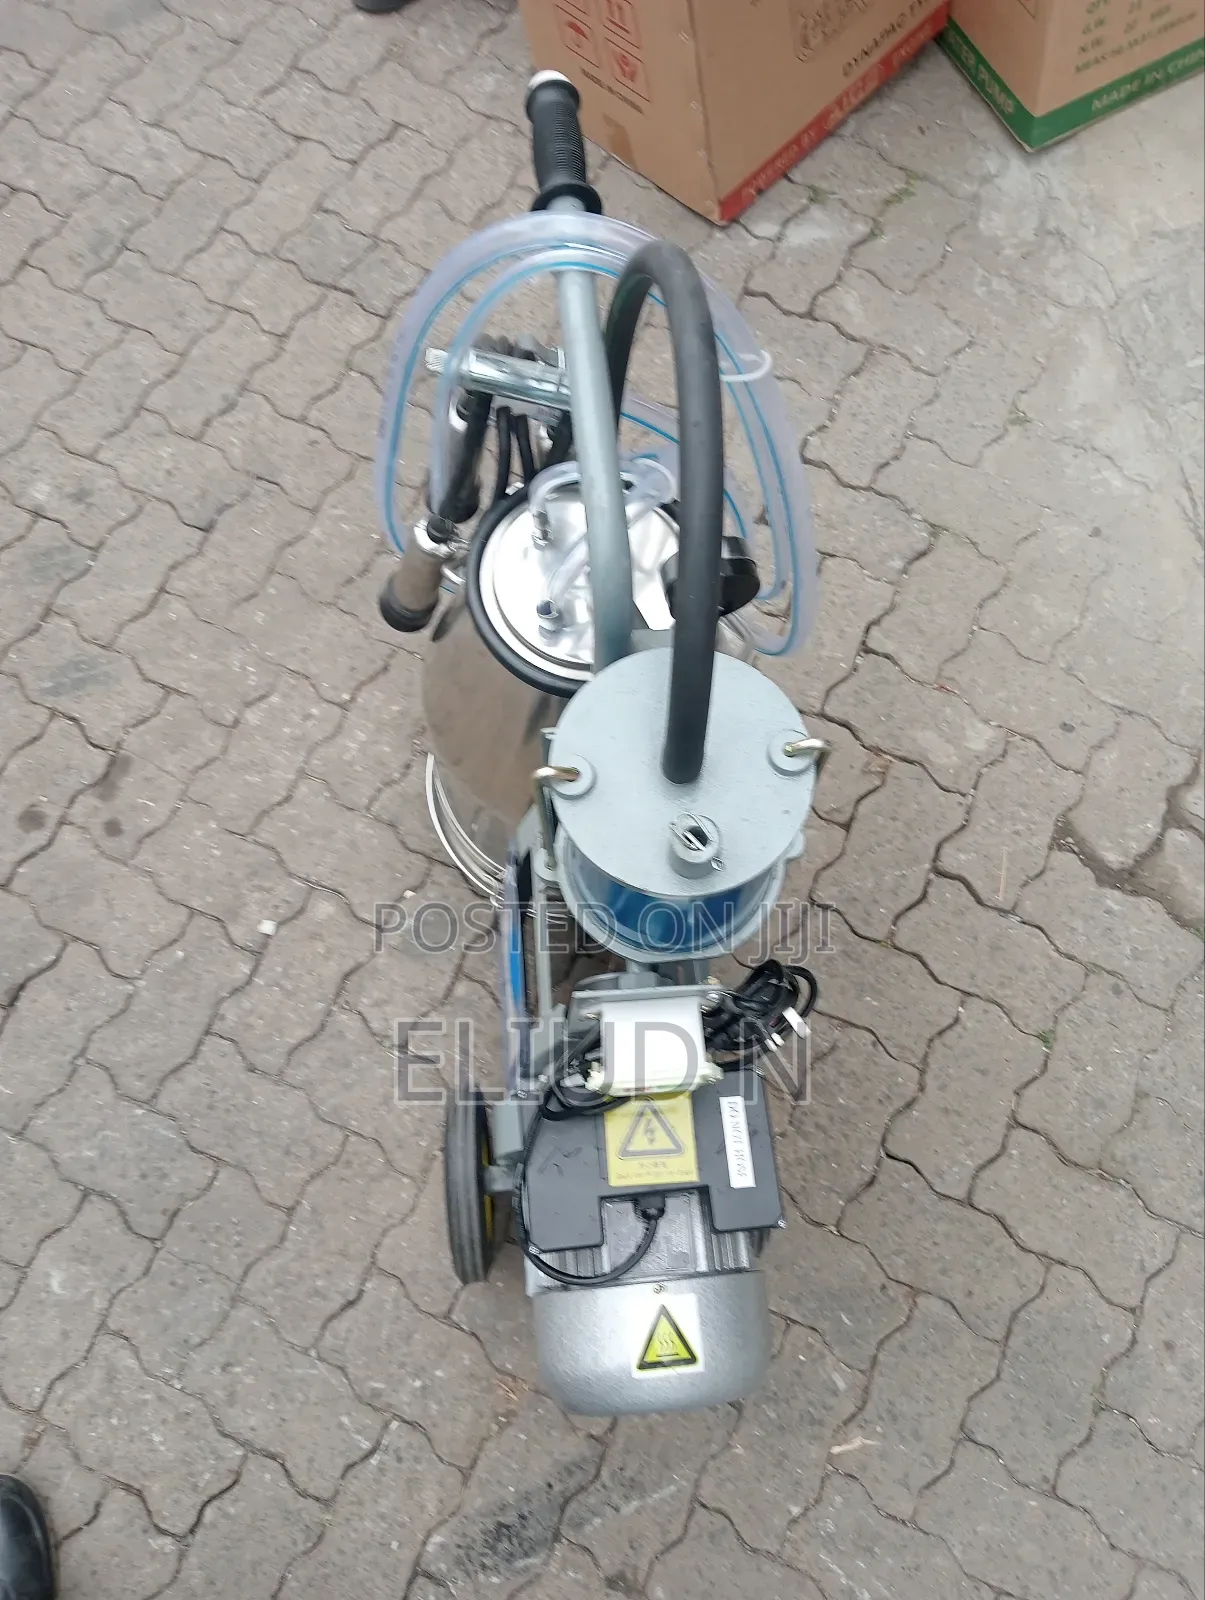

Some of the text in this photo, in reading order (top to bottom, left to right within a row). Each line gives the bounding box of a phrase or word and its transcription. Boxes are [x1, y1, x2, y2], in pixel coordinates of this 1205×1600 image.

[977, 64, 1014, 114] PUMP
[1091, 78, 1142, 111] MADE
[1144, 66, 1164, 85] IN
